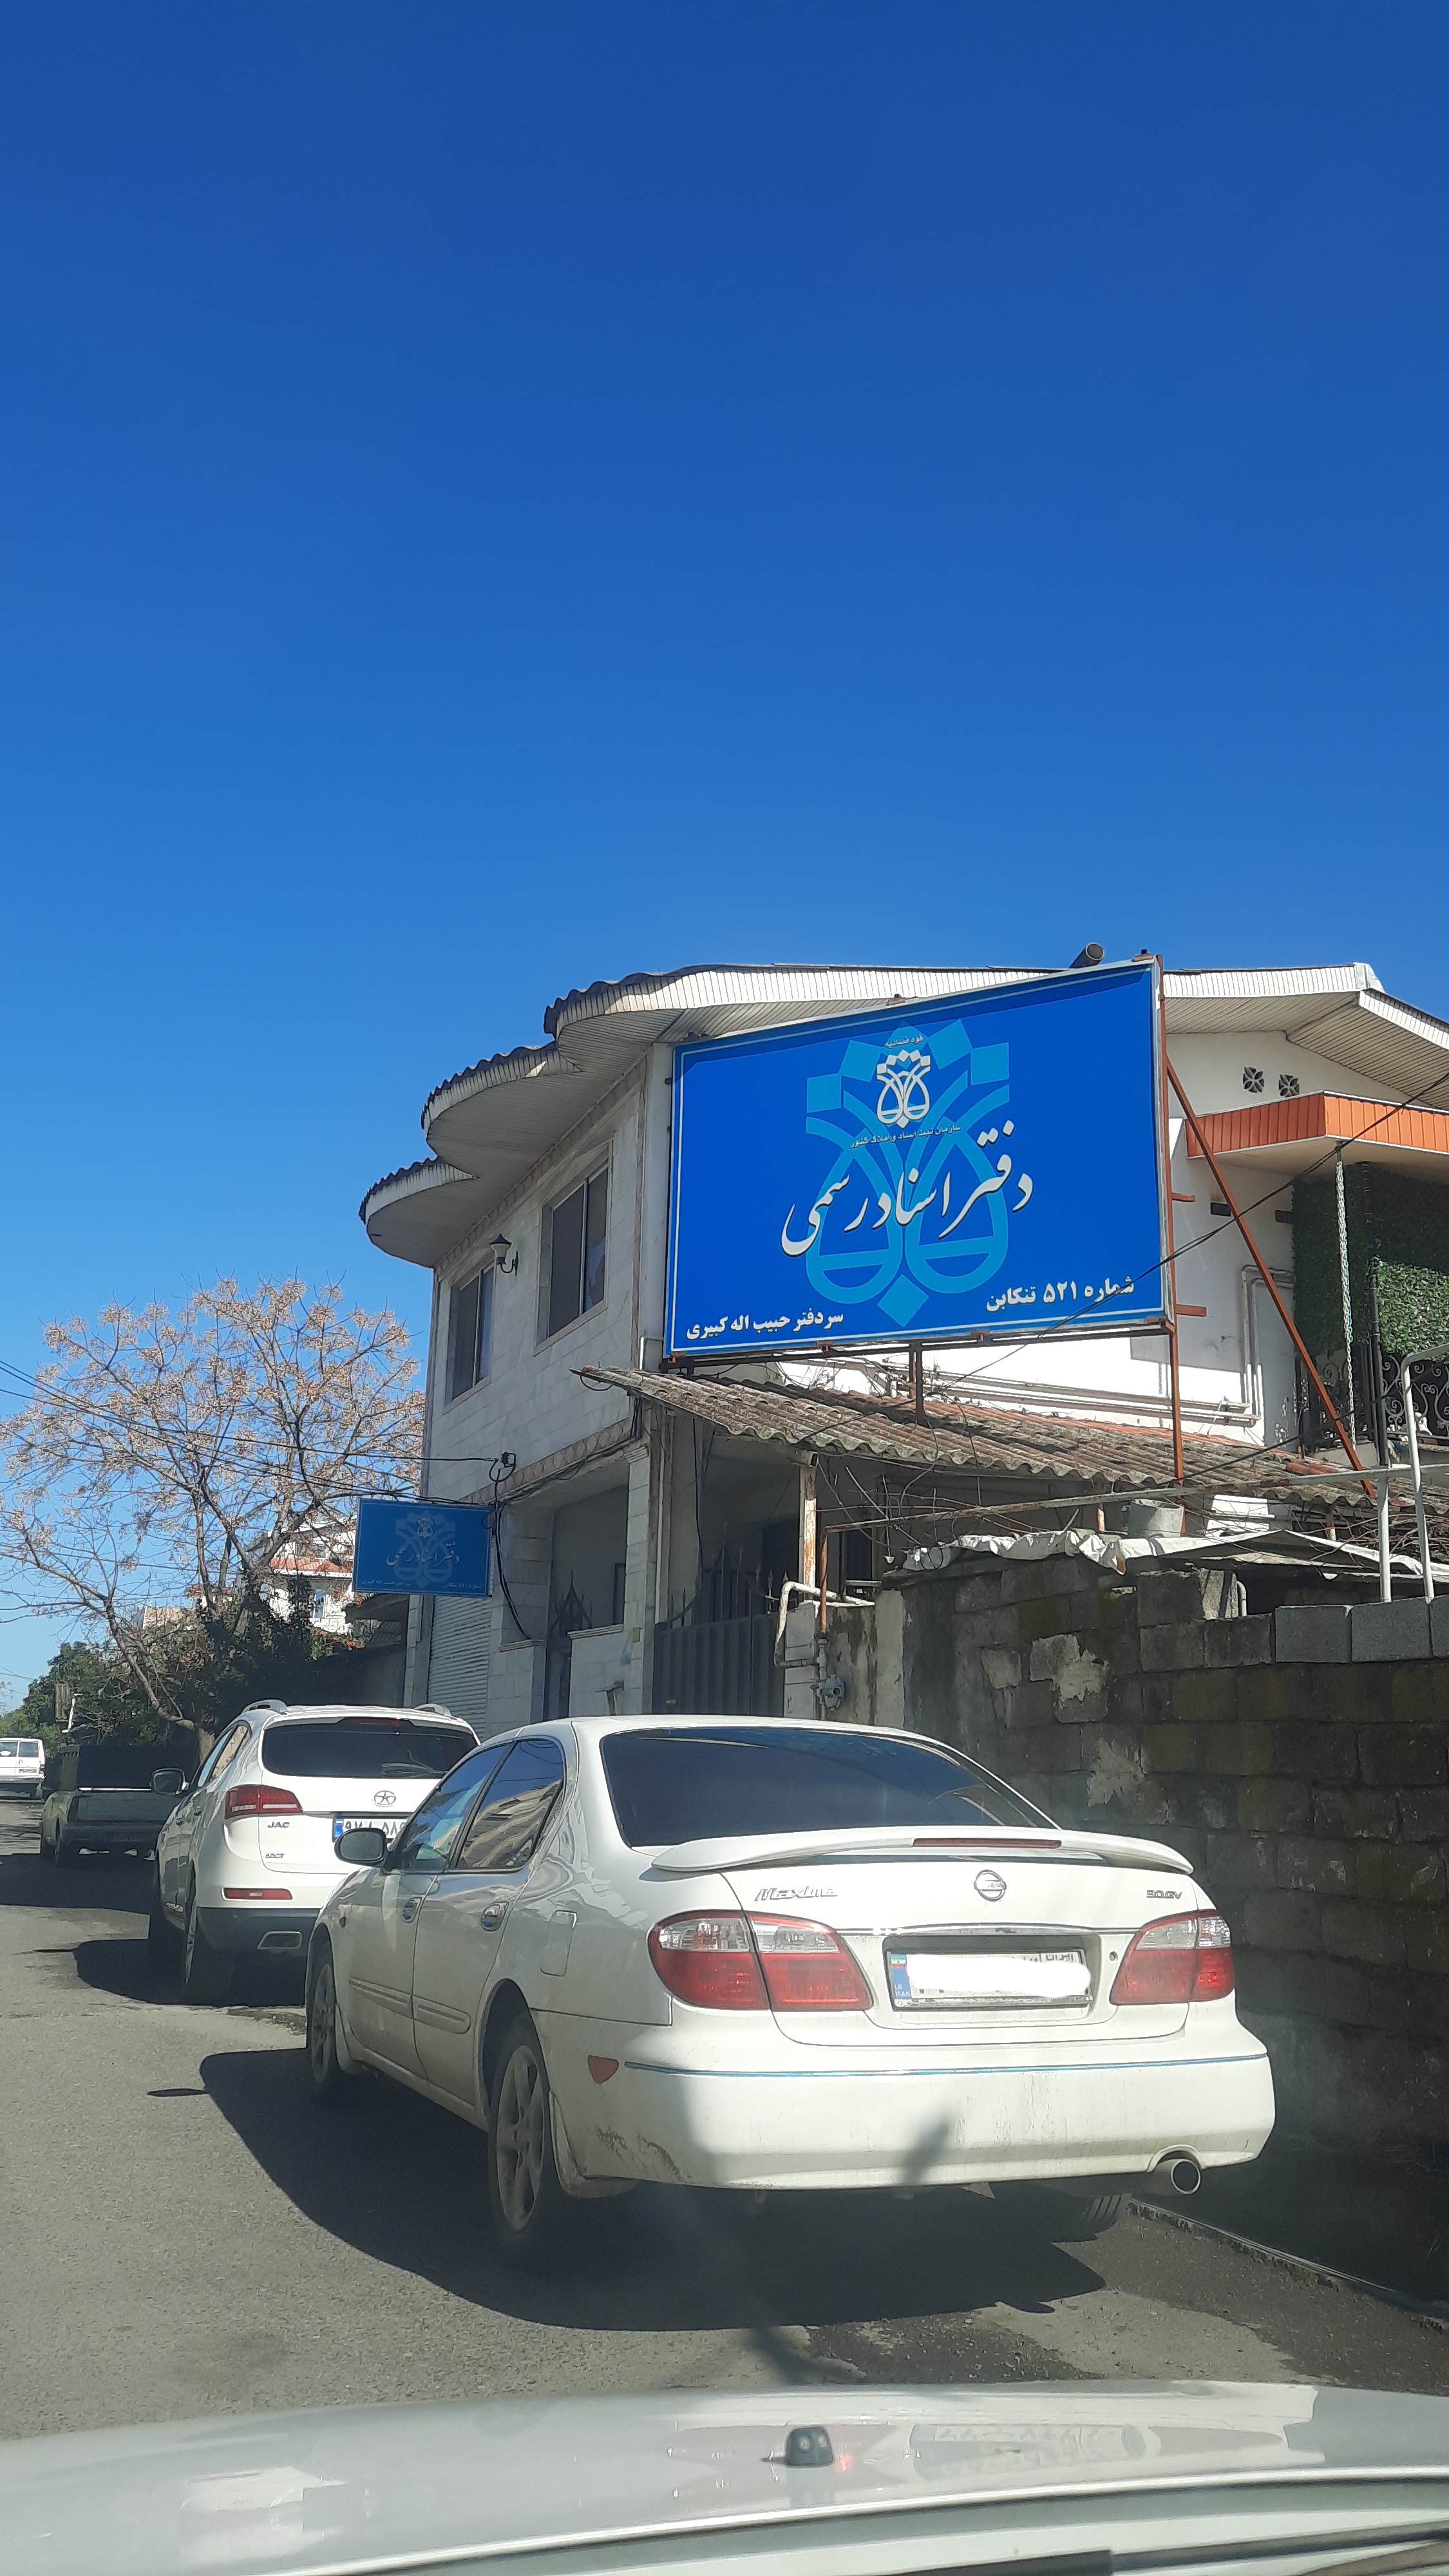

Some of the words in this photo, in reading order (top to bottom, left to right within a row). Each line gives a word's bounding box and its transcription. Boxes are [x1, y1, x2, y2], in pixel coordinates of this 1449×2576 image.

[898, 1130, 916, 1140] اسناد
[918, 1128, 934, 1138] ثبت
[935, 1124, 961, 1136] سازمان
[849, 1136, 869, 1149] کشور
[938, 1119, 1034, 1240] دفتر
[872, 1167, 951, 1230] اسناد
[781, 1173, 869, 1257] رسمی
[985, 1285, 1037, 1313] تنکابن
[1042, 1280, 1077, 1304] ۵۲۱
[1084, 1275, 1135, 1303] شماره
[686, 1316, 729, 1340] کبیری
[730, 1314, 750, 1332] اله
[752, 1314, 791, 1334] حبیب
[432, 1542, 460, 1568] دفتر
[754, 1886, 837, 1902] Maxima
